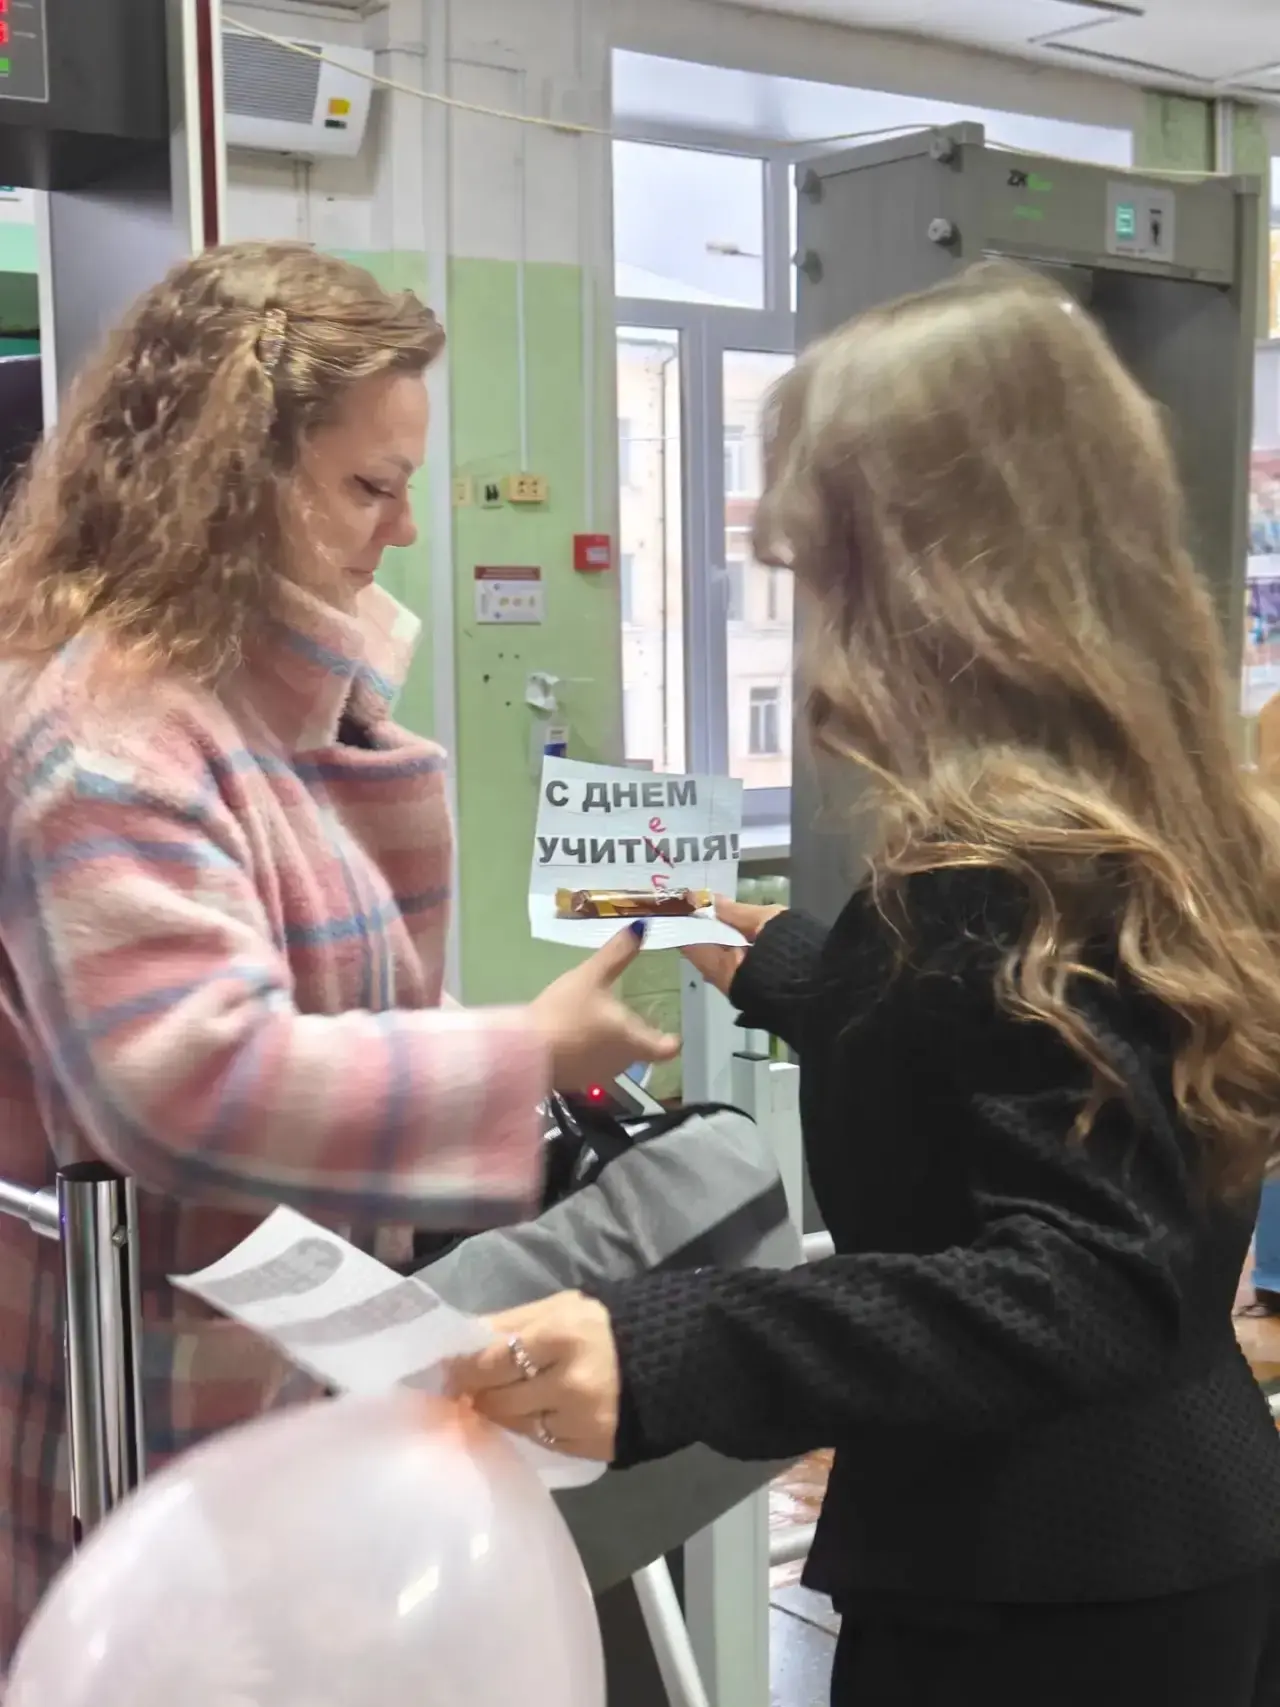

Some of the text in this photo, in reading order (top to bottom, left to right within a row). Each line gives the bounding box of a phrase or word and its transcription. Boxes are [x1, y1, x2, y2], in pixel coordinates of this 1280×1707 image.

[545, 780, 697, 812] С ДНЕМ
[537, 834, 739, 865] УЧИТИЛЯ!
